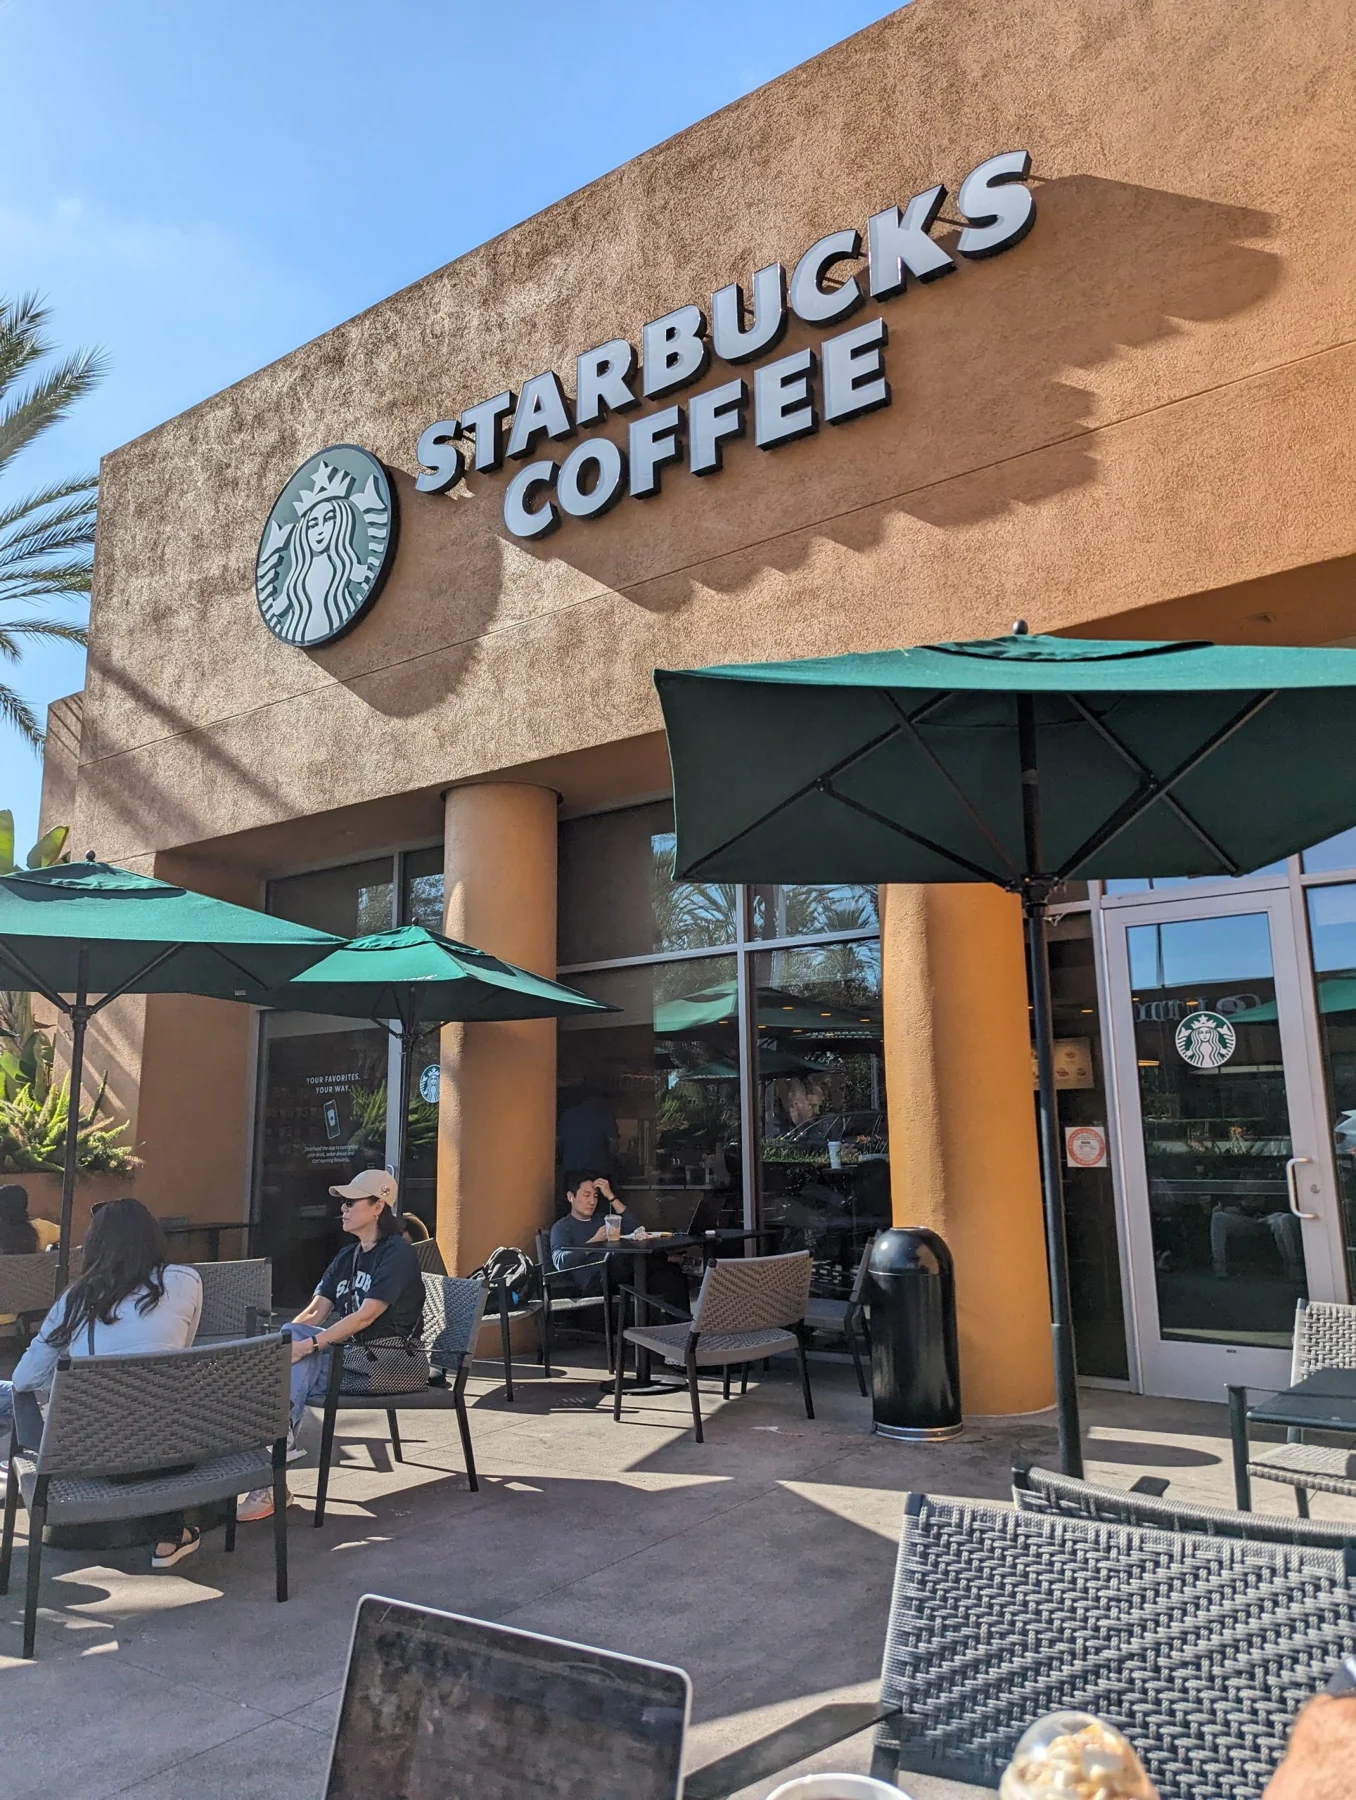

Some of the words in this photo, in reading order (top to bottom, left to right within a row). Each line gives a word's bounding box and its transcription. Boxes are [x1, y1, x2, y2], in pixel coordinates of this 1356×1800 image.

[415, 150, 1036, 495] STARBUCKS
[503, 317, 892, 540] COFFEE
[306, 1076, 324, 1084] YOUR
[325, 1073, 361, 1083] FAVORITES.
[316, 1086, 333, 1094] YOUR
